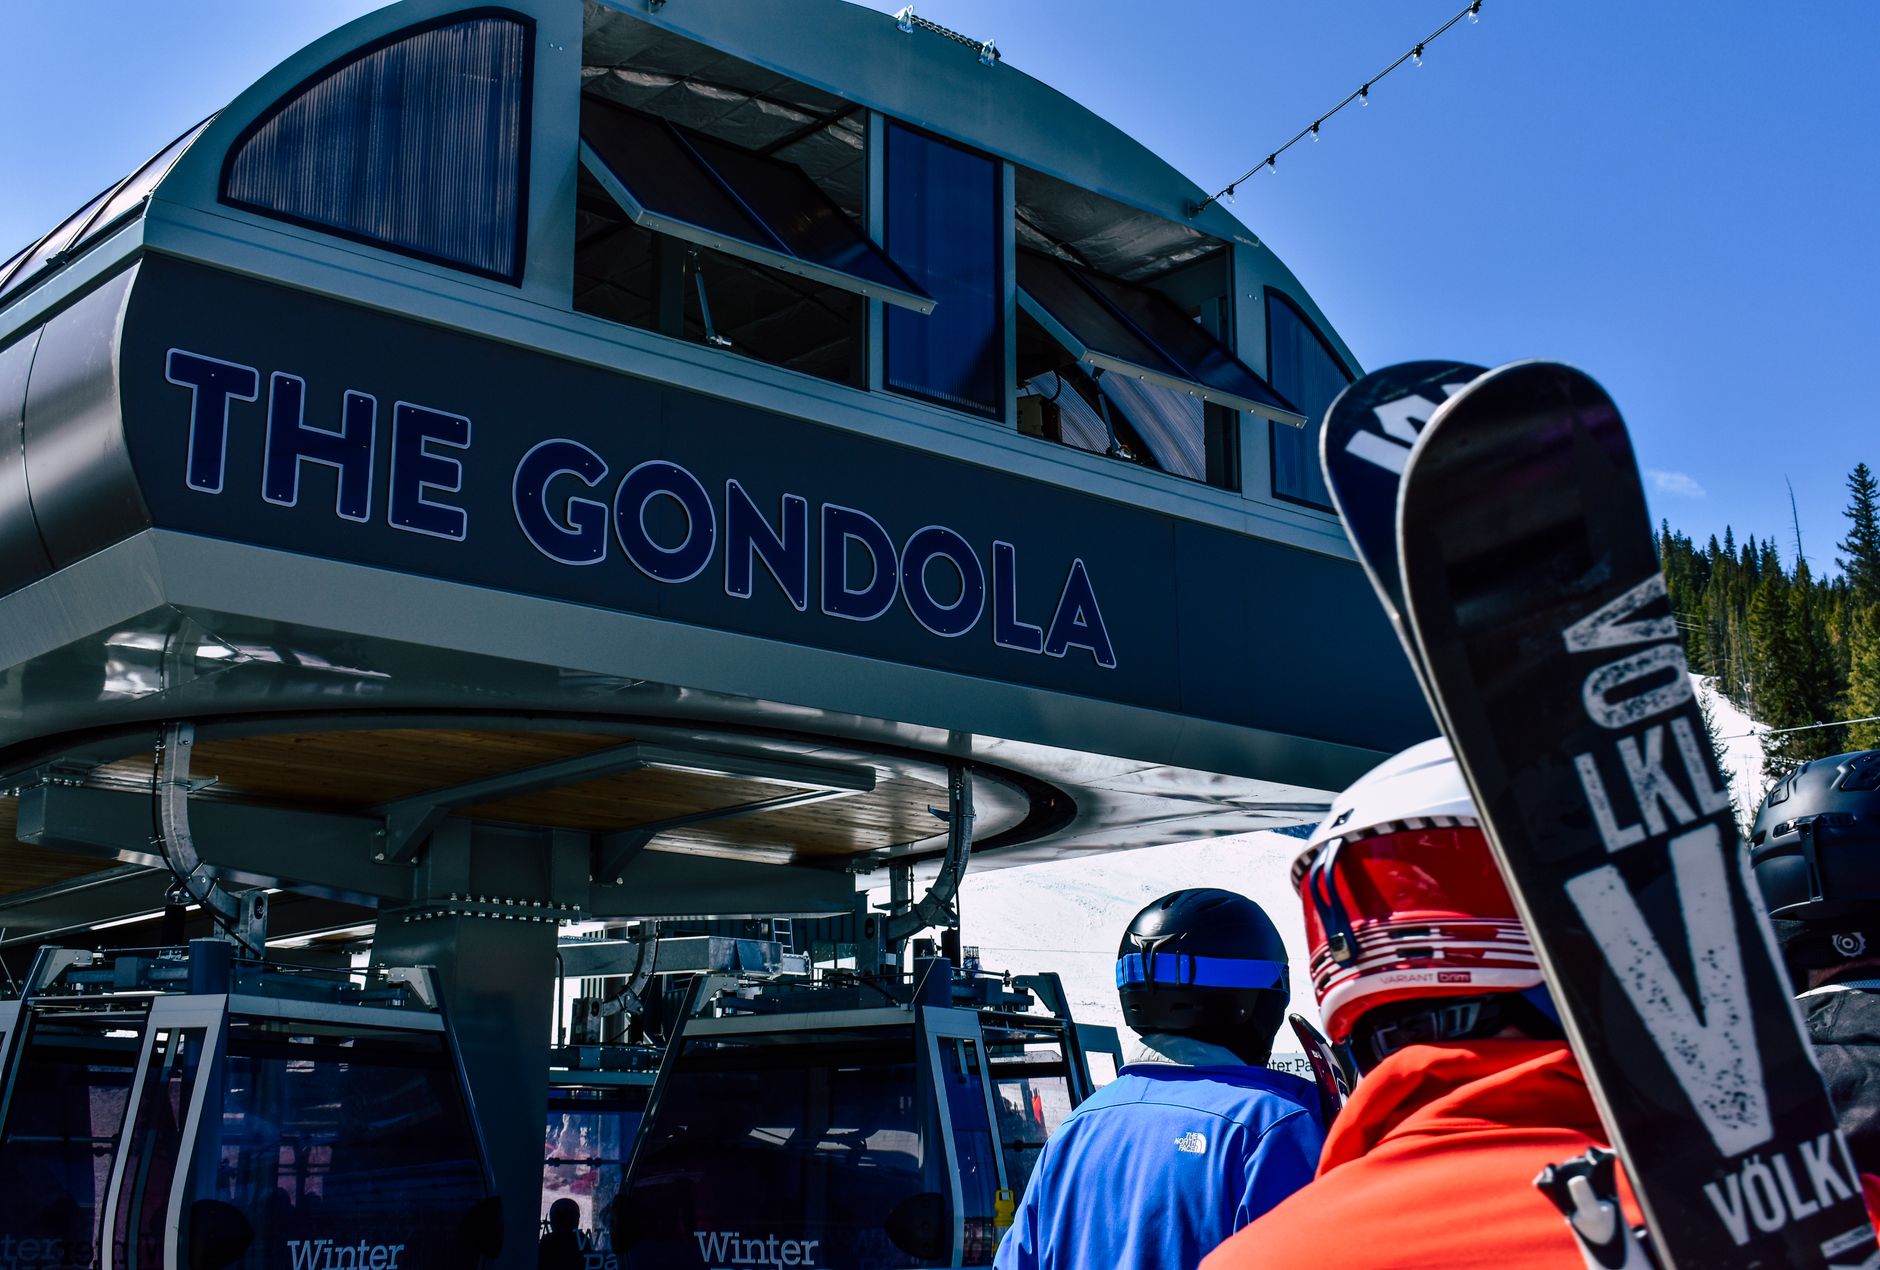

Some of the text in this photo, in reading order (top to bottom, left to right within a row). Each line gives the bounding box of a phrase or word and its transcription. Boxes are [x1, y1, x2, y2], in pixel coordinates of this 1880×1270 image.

[165, 347, 1117, 669] THE GONDOLA
[1380, 973, 1434, 985] VARIANT
[0, 1232, 65, 1262] ter
[287, 1239, 405, 1270] Winter
[693, 1231, 819, 1267] Winter
